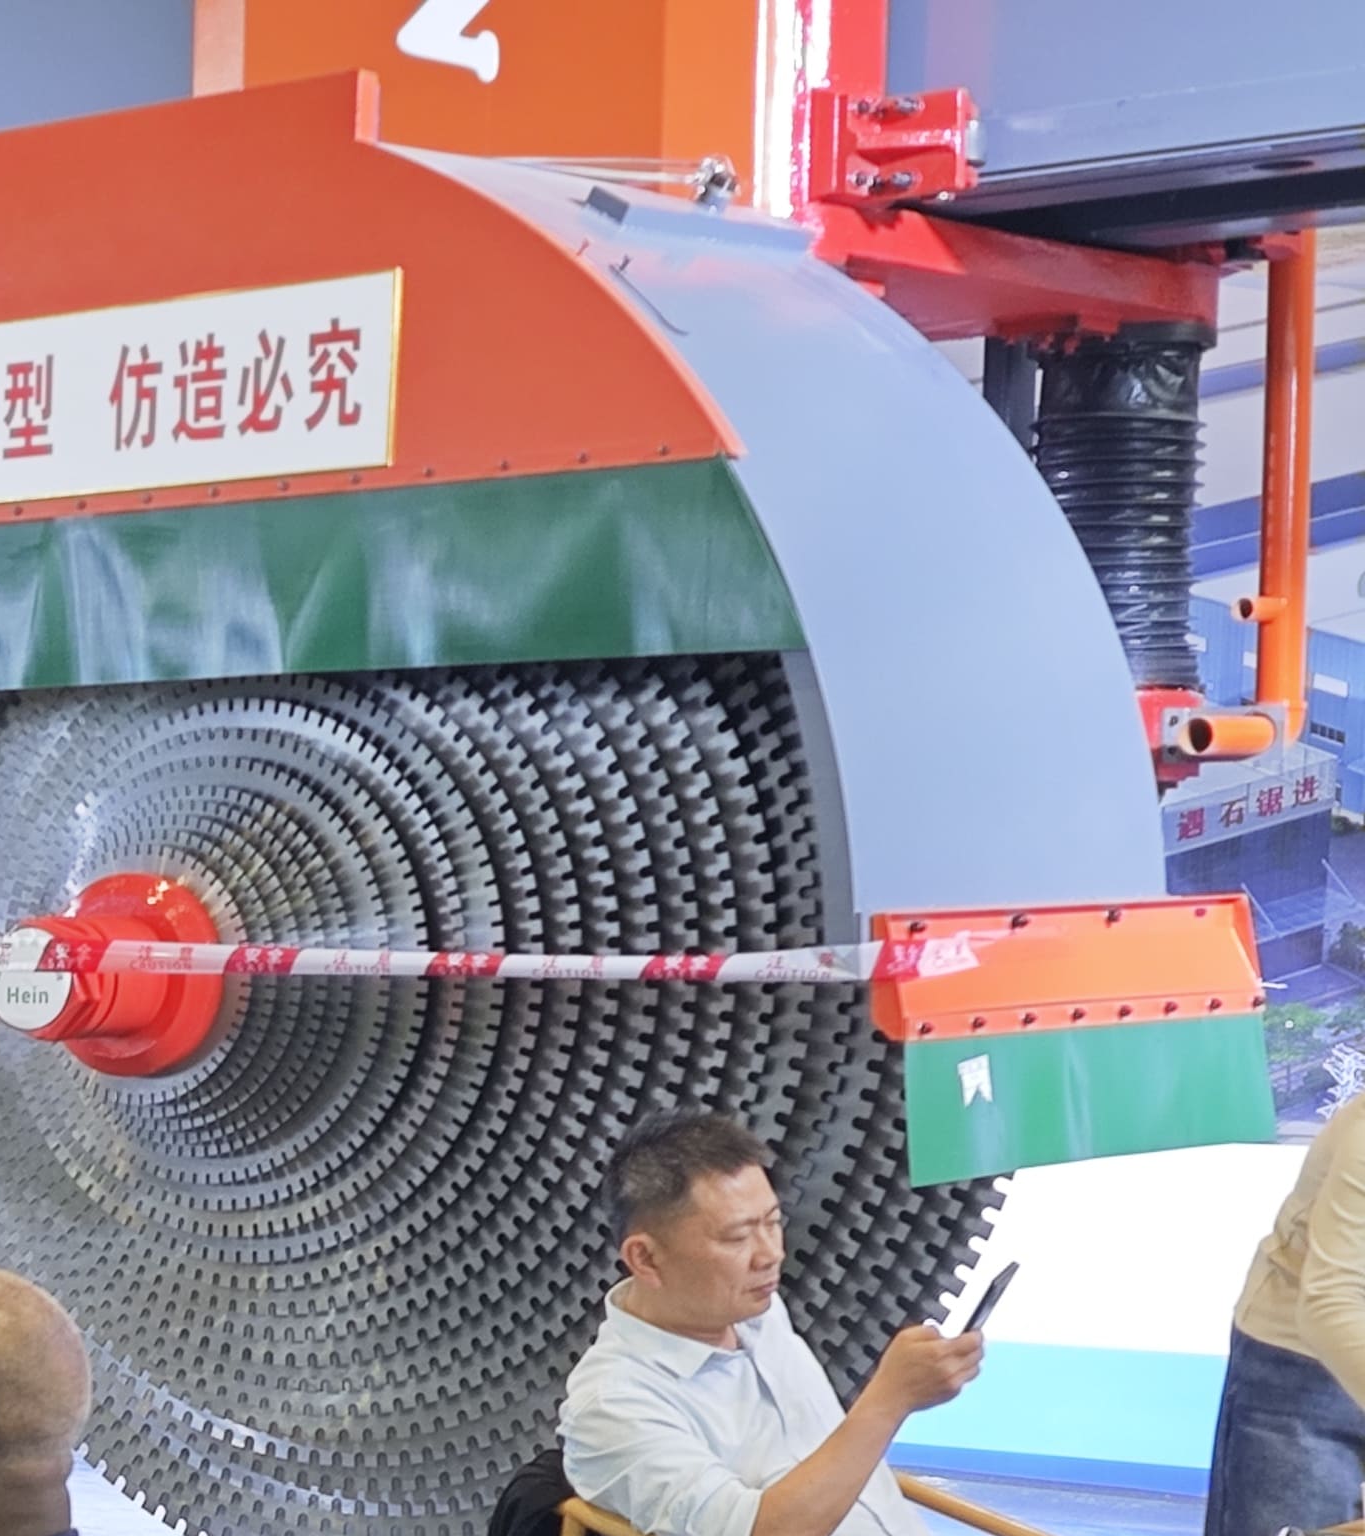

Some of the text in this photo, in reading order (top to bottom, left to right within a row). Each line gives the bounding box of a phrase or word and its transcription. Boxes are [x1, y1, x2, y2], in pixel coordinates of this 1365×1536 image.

[108, 317, 362, 451] 仿造必究
[7, 986, 49, 1004] Hein
